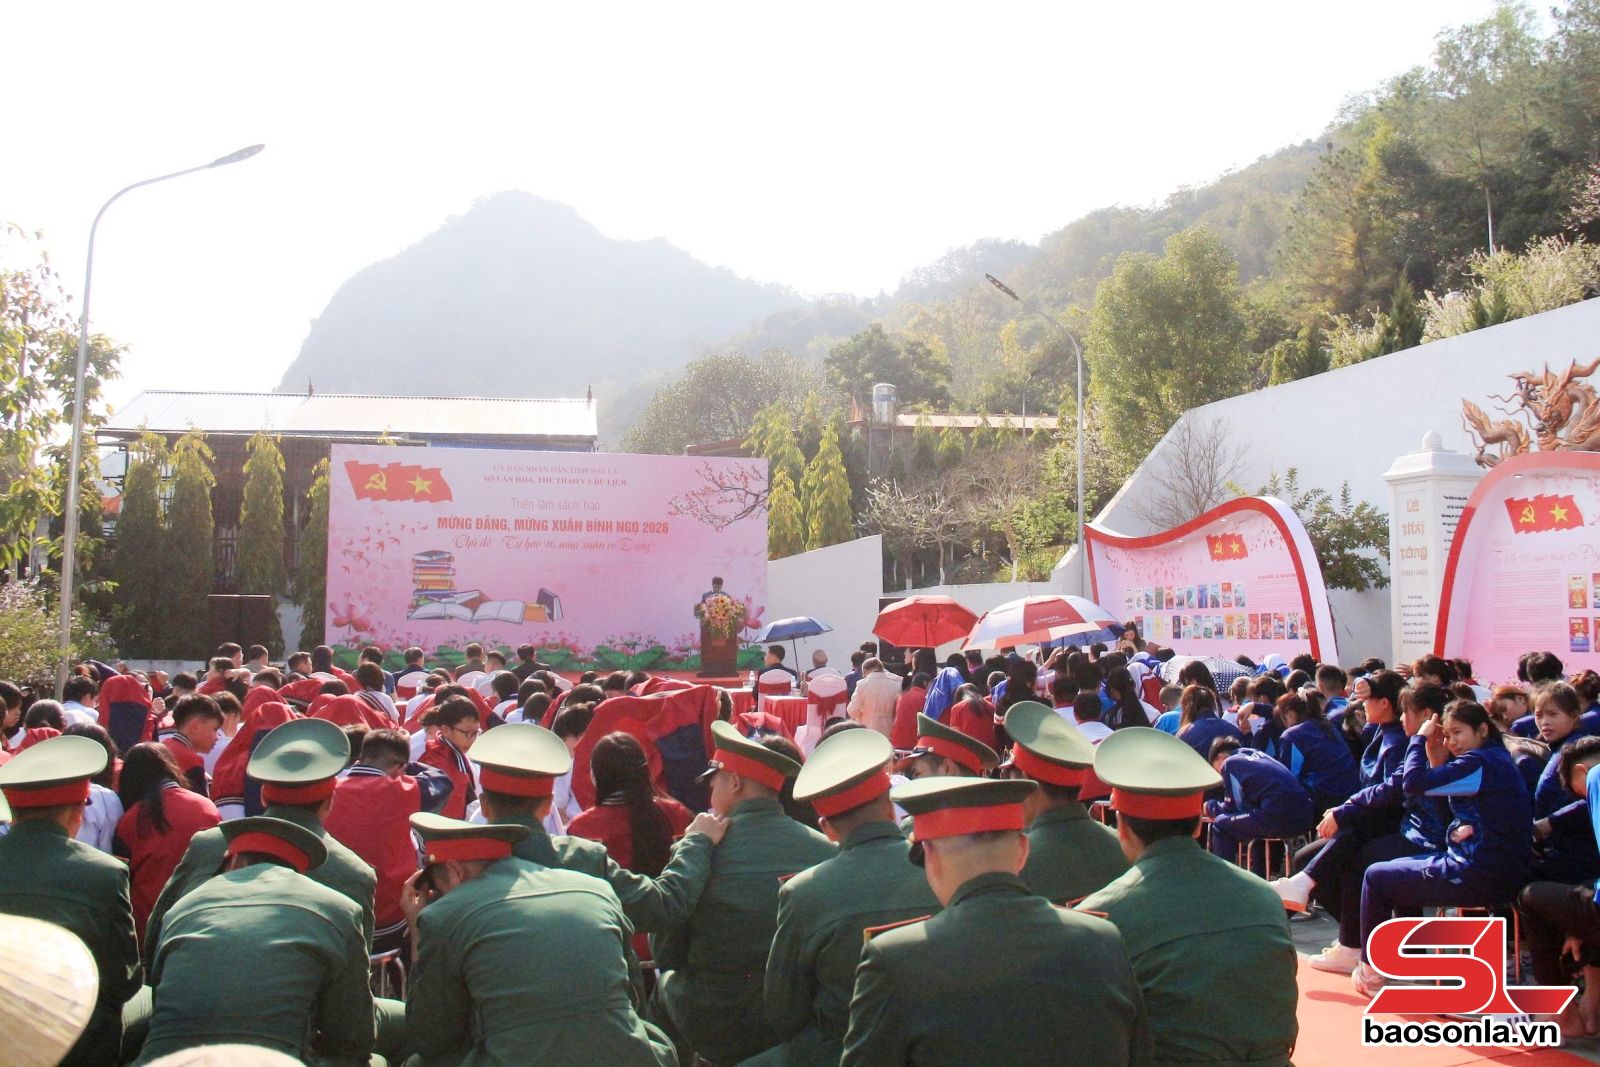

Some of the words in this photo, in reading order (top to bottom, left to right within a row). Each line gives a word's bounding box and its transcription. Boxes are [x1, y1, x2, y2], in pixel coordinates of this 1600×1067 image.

[437, 515, 473, 530] MỪNG
[475, 514, 511, 532] ĐẢNG,
[514, 516, 549, 532] MỪNG
[551, 518, 583, 533] XUÂN
[586, 518, 613, 533] BÍNH
[616, 521, 639, 536] NGỌ
[642, 521, 669, 534] 2026
